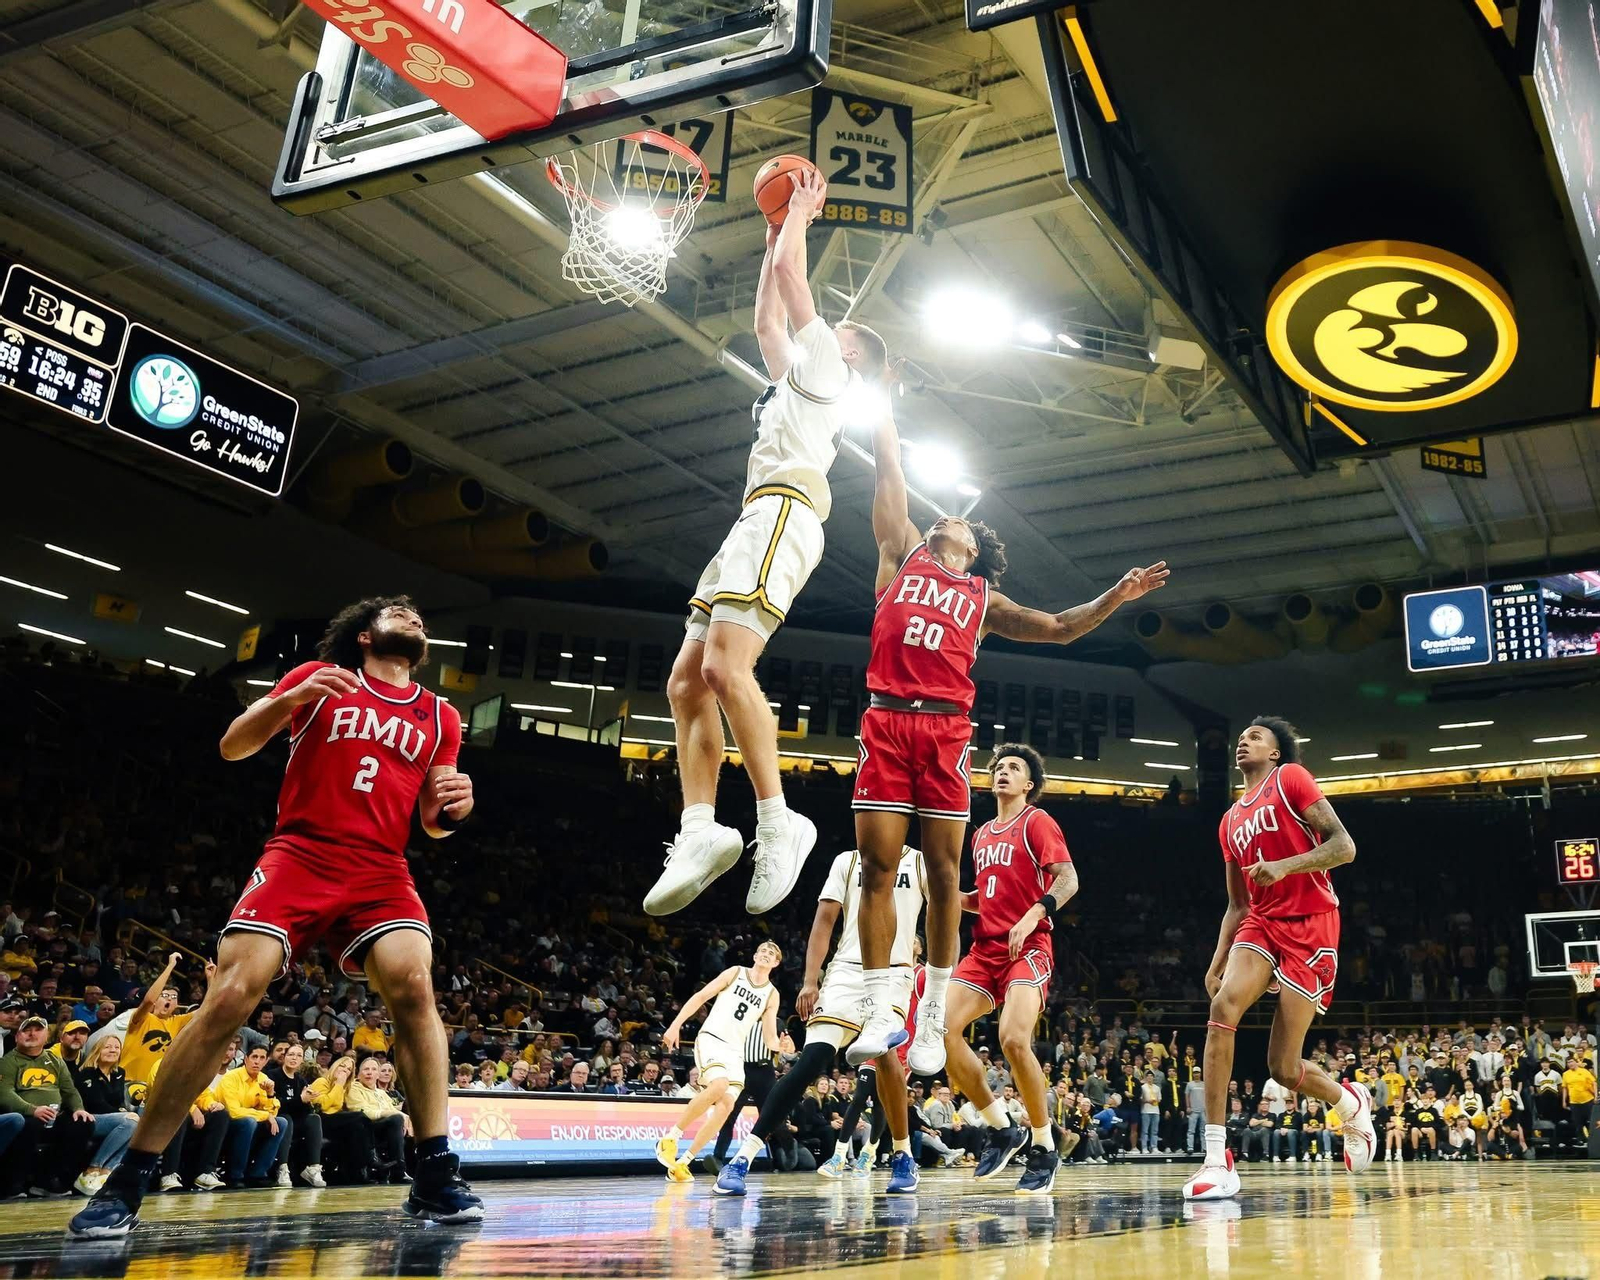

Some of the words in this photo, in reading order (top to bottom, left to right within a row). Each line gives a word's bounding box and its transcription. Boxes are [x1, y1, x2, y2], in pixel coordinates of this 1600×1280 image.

[836, 130, 889, 148] MARBLE
[829, 145, 896, 191] 23
[823, 204, 907, 227] 986-89
[45, 348, 68, 367] POSS
[28, 355, 76, 391] 16:24
[36, 382, 58, 401] 2ND
[81, 378, 103, 400] 35
[203, 395, 285, 444] GreenState
[202, 411, 242, 435] CREDIT
[247, 432, 279, 453] UNION
[190, 430, 211, 452] Go
[217, 439, 275, 473] Hawks!
[1424, 451, 1483, 473] 1982-85
[1503, 583, 1525, 593] IOWA
[893, 574, 977, 630] RMU
[1521, 606, 1527, 615] 1
[1531, 605, 1538, 614] 2
[1532, 615, 1538, 625] 2
[903, 614, 945, 651] 20
[1421, 636, 1476, 650] GreenState
[1510, 629, 1517, 638] 2
[1533, 626, 1540, 636] 2
[1427, 646, 1450, 655] CREDIT
[1450, 645, 1471, 653] UNION
[1525, 649, 1531, 659] 2
[326, 705, 427, 763] RMU
[352, 755, 380, 793] 2
[1232, 804, 1279, 858] RMU
[976, 842, 1014, 875] RMU
[1564, 843, 1595, 857] 16:24
[1565, 856, 1594, 879] 26
[857, 872, 911, 889] IA
[985, 874, 997, 899] 0
[733, 984, 762, 1009] IOWA
[733, 1002, 749, 1021] 8
[550, 1124, 590, 1141] ENJOY
[594, 1125, 668, 1141] RESPONSIBLY
[462, 1140, 494, 1151] VODKA
